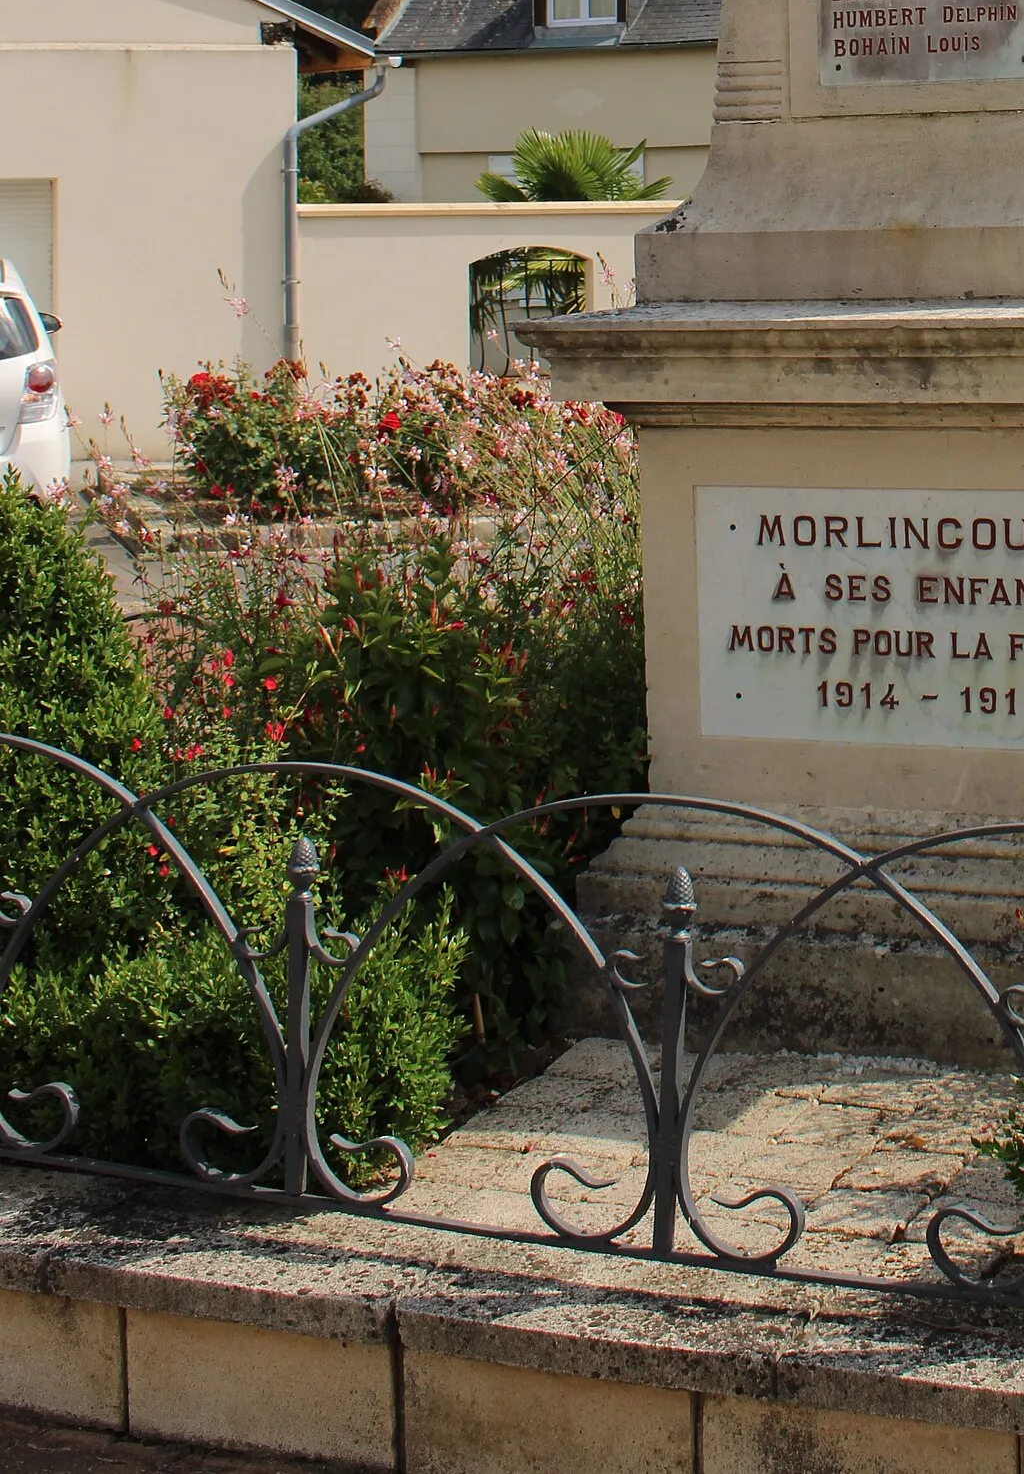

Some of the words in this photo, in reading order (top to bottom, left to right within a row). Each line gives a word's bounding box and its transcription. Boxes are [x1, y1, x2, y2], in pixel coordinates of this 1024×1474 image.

[833, 7, 926, 29] HUMBERT
[943, 2, 1017, 23] DELPHIN
[834, 32, 910, 57] BOHAIN
[927, 32, 980, 54] LOUIS
[772, 562, 797, 602] À
[824, 573, 892, 602] SES
[727, 624, 837, 656] MORTS
[852, 628, 936, 659] POUR
[951, 631, 994, 661] LA
[816, 680, 899, 711] 1914
